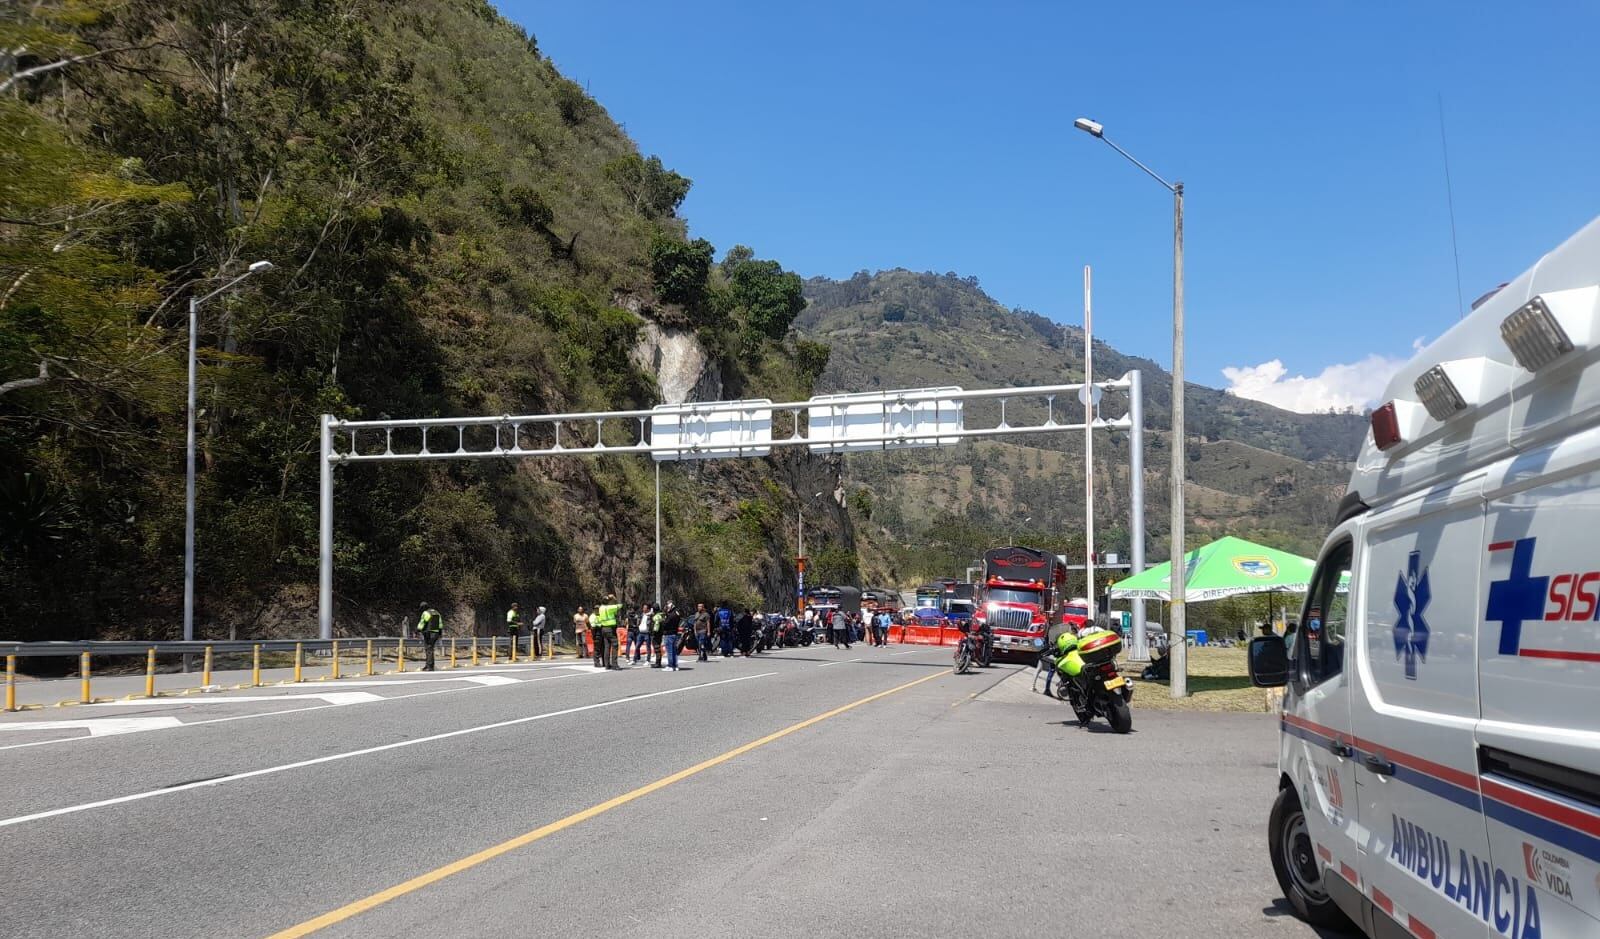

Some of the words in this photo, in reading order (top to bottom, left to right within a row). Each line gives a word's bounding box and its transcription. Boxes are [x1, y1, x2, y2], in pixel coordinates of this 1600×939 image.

[1545, 572, 1600, 621] SIS
[1391, 812, 1542, 939] AMBULANCIA
[1545, 871, 1573, 901] VIDA
